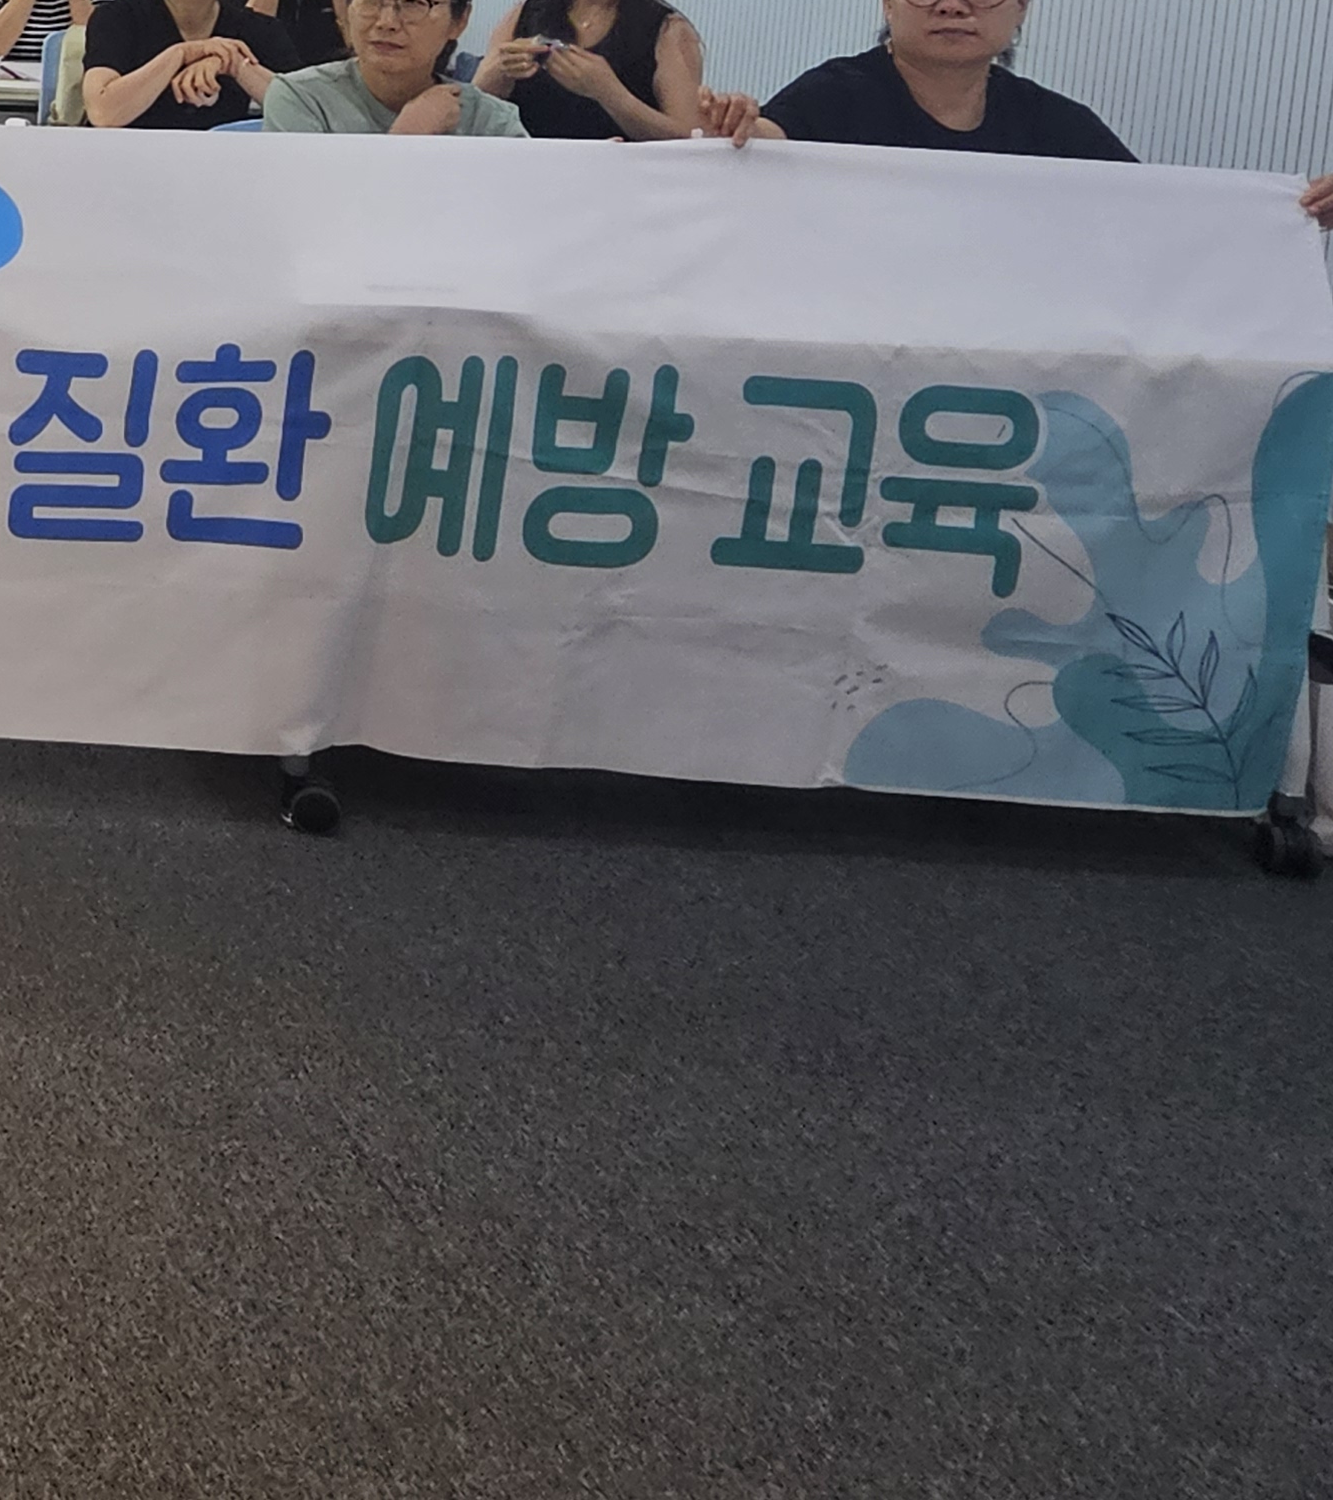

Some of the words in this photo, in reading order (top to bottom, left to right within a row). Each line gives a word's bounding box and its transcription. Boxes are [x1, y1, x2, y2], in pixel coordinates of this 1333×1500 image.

[8, 343, 332, 550] 질환
[365, 355, 695, 569] 예방
[710, 375, 1040, 598] 교육
